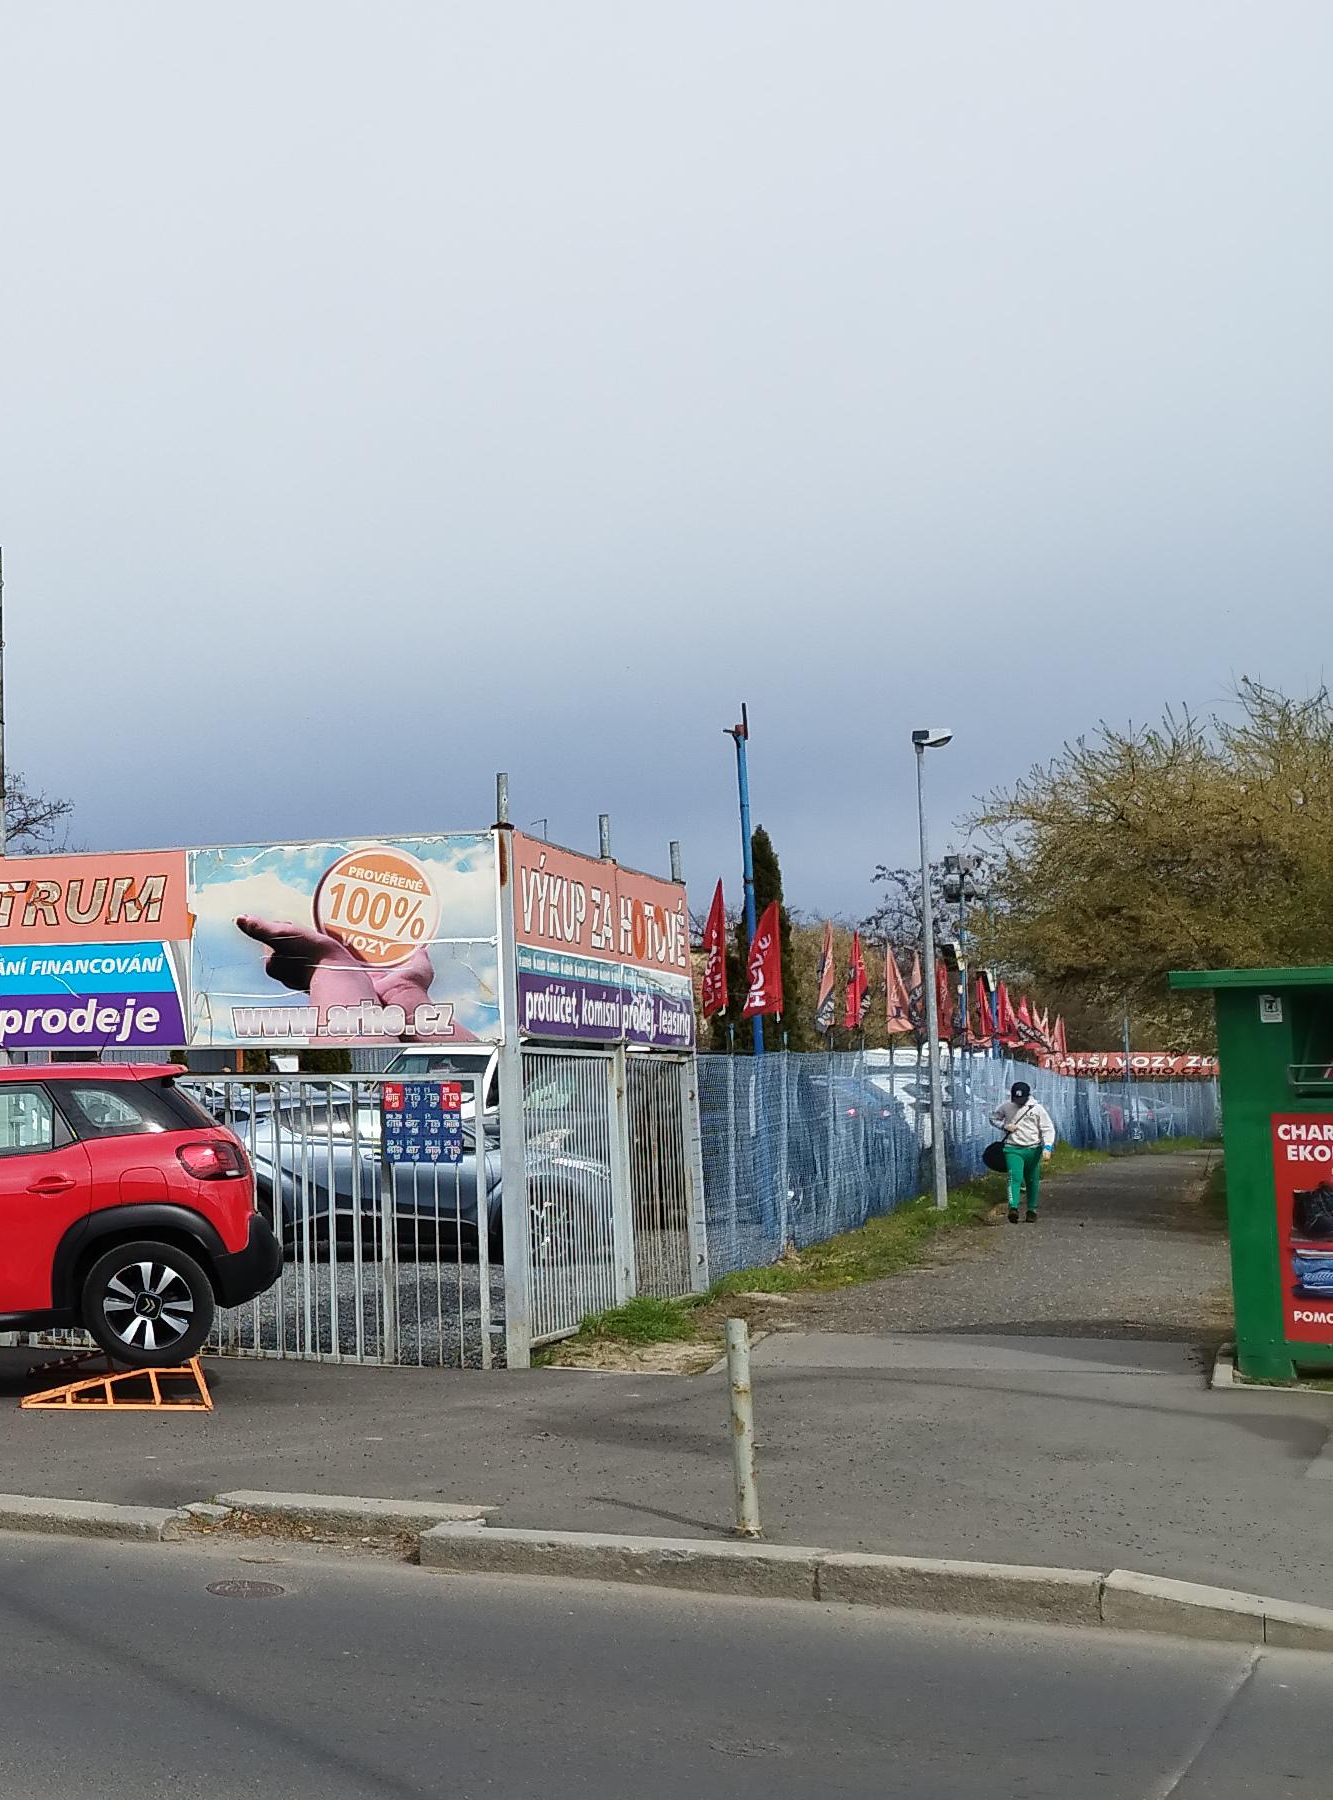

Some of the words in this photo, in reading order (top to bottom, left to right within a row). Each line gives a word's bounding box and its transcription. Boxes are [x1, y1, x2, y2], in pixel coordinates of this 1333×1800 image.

[348, 866, 424, 891] PROVĚŘENÉ
[330, 883, 425, 940] 100%
[521, 852, 587, 944] VÝKUP
[591, 887, 614, 952] ZA
[341, 932, 391, 956] VOZY
[29, 952, 164, 975] FINANCOVÁNÍ
[231, 999, 454, 1038] www.arho.cz
[582, 987, 620, 1028] komisní
[659, 1001, 691, 1045] leasing
[1116, 1055, 1179, 1067] VOZY
[1278, 1124, 1333, 1140] CHAR
[1287, 1145, 1333, 1162] EKO
